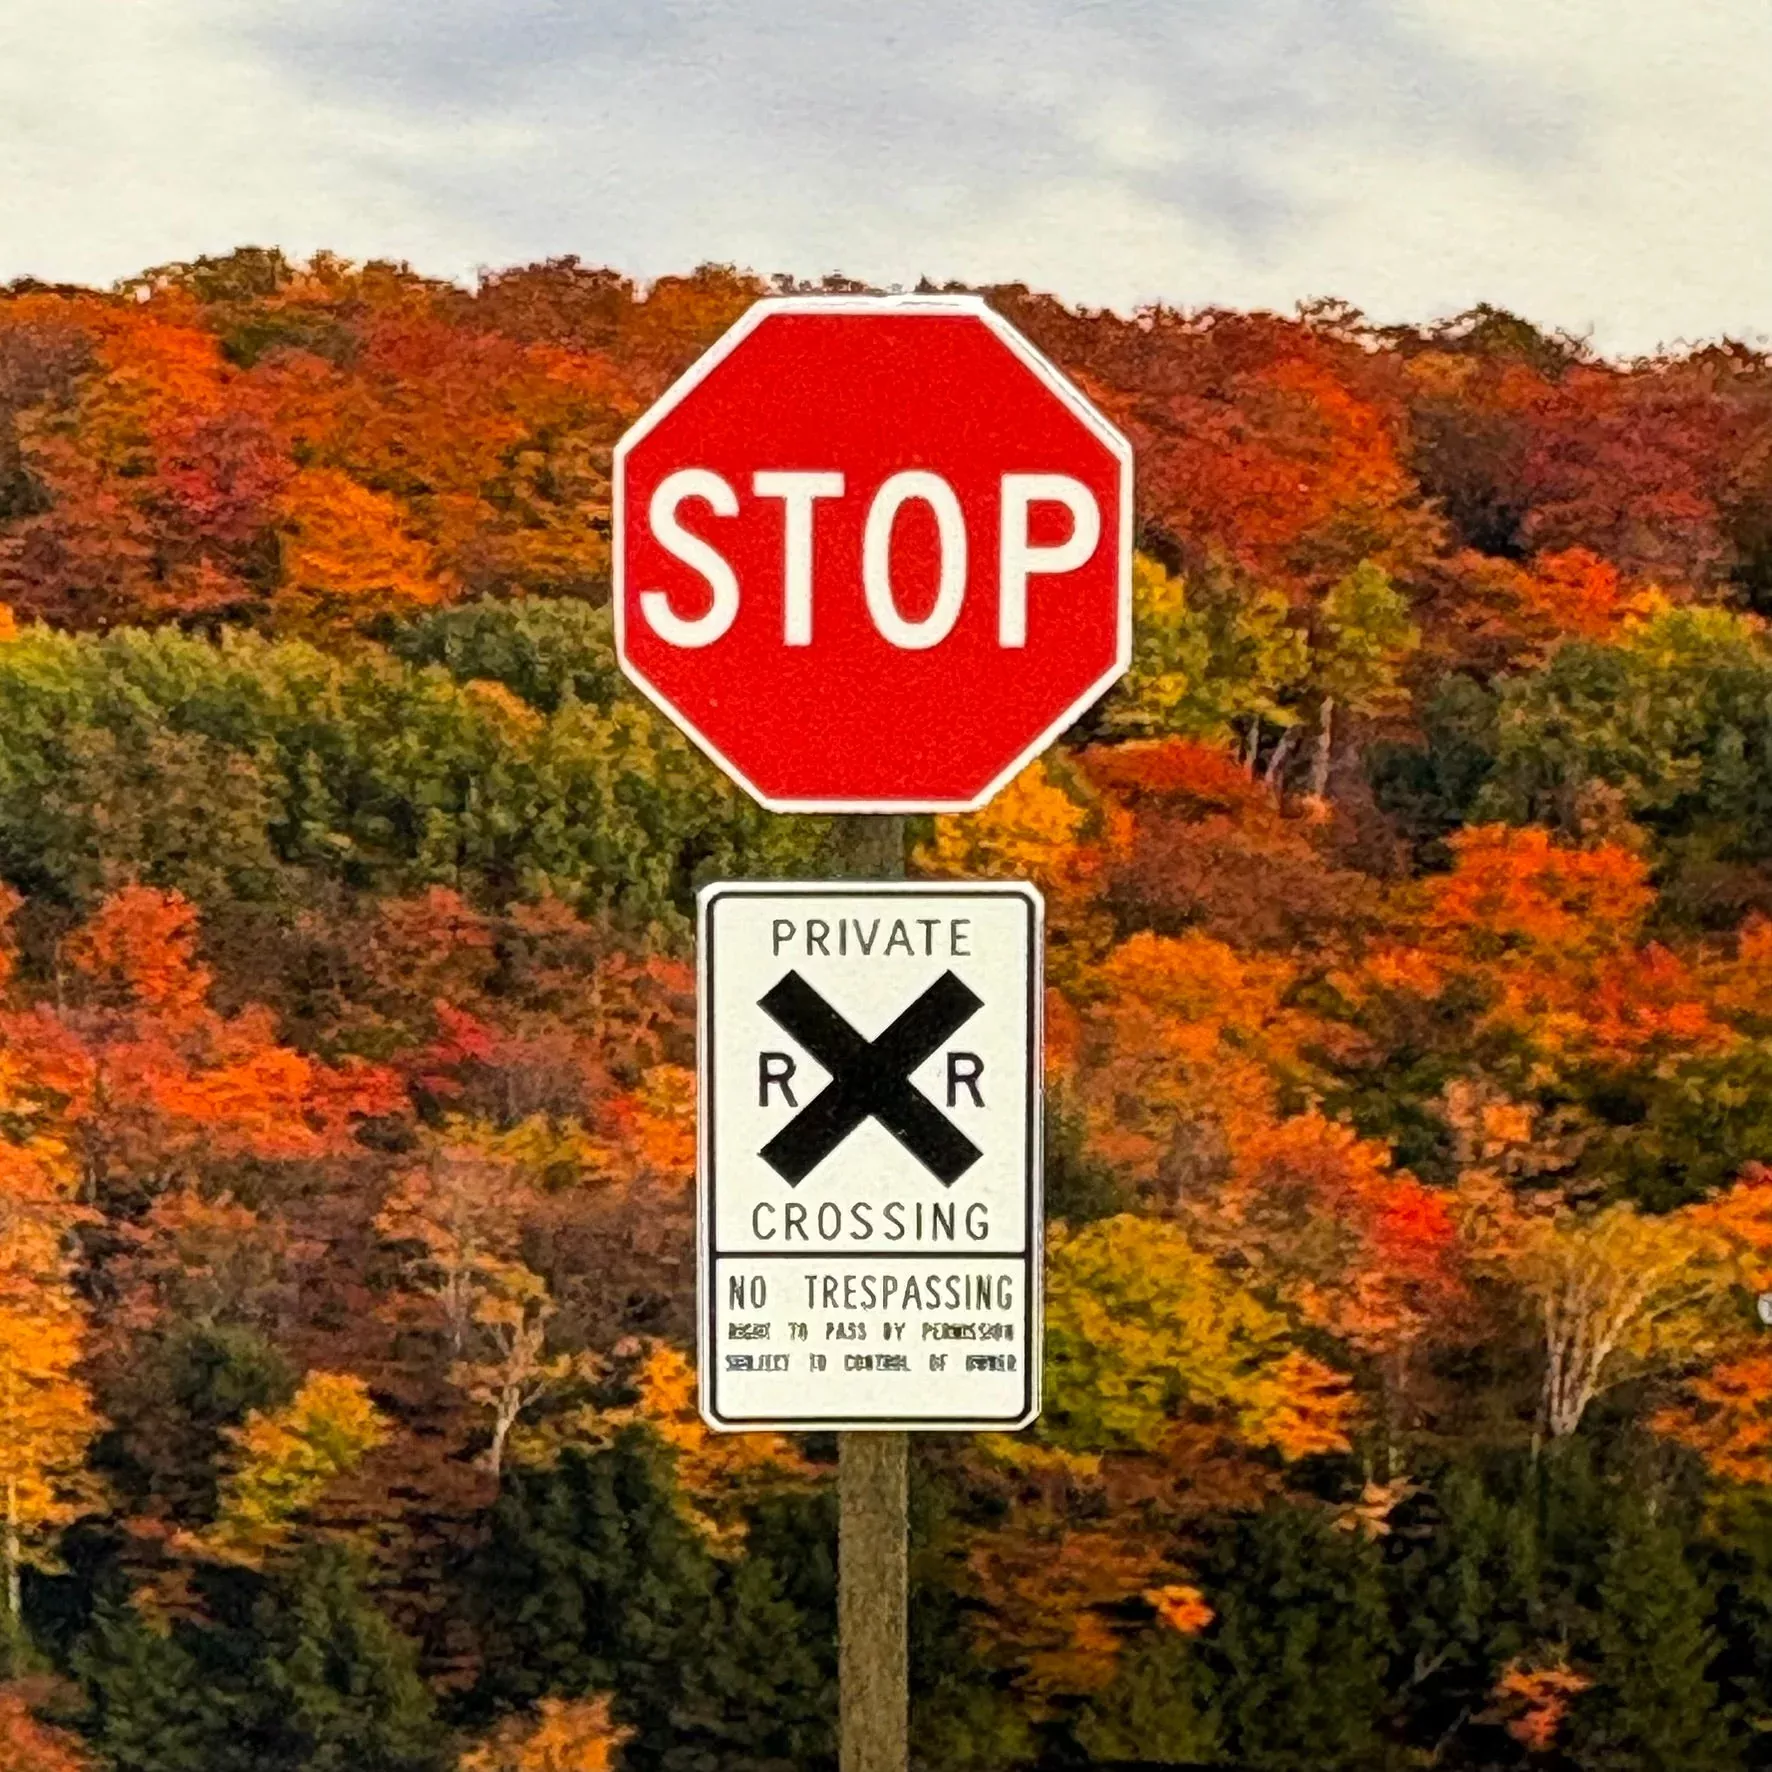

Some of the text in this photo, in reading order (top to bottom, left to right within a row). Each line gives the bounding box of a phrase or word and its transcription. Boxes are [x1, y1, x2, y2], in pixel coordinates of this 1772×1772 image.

[639, 468, 1102, 650] STOP
[772, 918, 971, 957] PRIVATE
[758, 1051, 987, 1108] R R
[752, 1201, 989, 1241] CROSSING
[729, 1274, 1013, 1311] NO TRESPASSING
[825, 1322, 867, 1342] PASS
